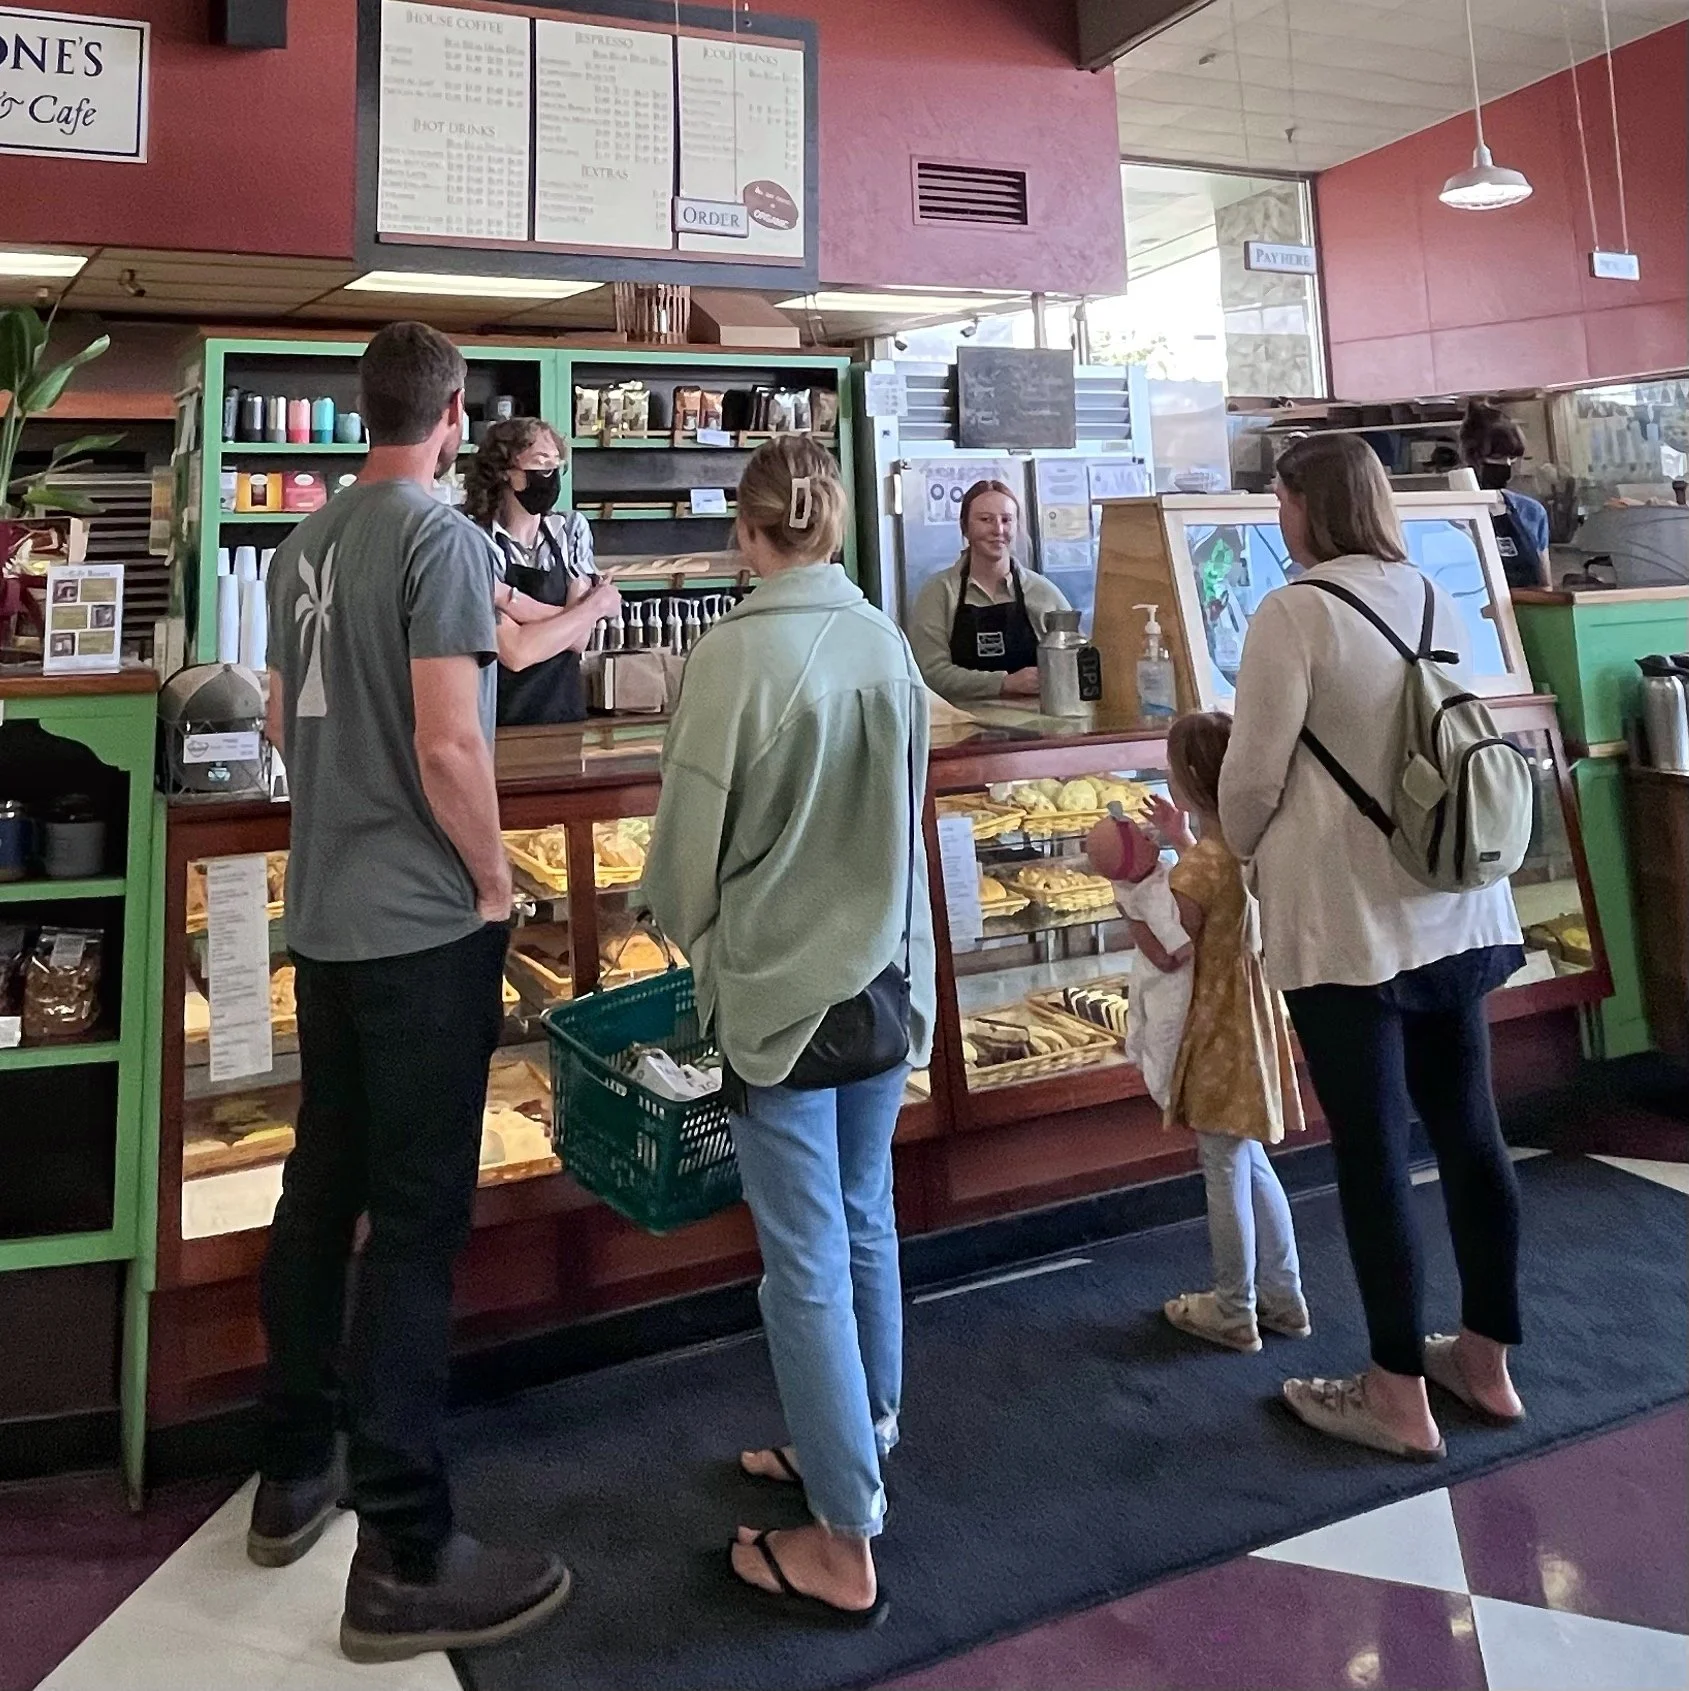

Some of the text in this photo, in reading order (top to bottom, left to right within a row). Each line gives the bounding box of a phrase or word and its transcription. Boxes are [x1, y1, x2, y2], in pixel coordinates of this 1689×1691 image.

[406, 10, 453, 27] HOUSE
[575, 31, 633, 49] ESPRESSO
[0, 33, 103, 77] NE'S
[29, 95, 97, 135] Cafe
[413, 118, 496, 138] HOT DRINKS
[581, 164, 629, 180] EXTRAS
[683, 206, 740, 227] ORDER
[1255, 248, 1311, 267] PAY HERE
[1080, 655, 1099, 697] TIPS
